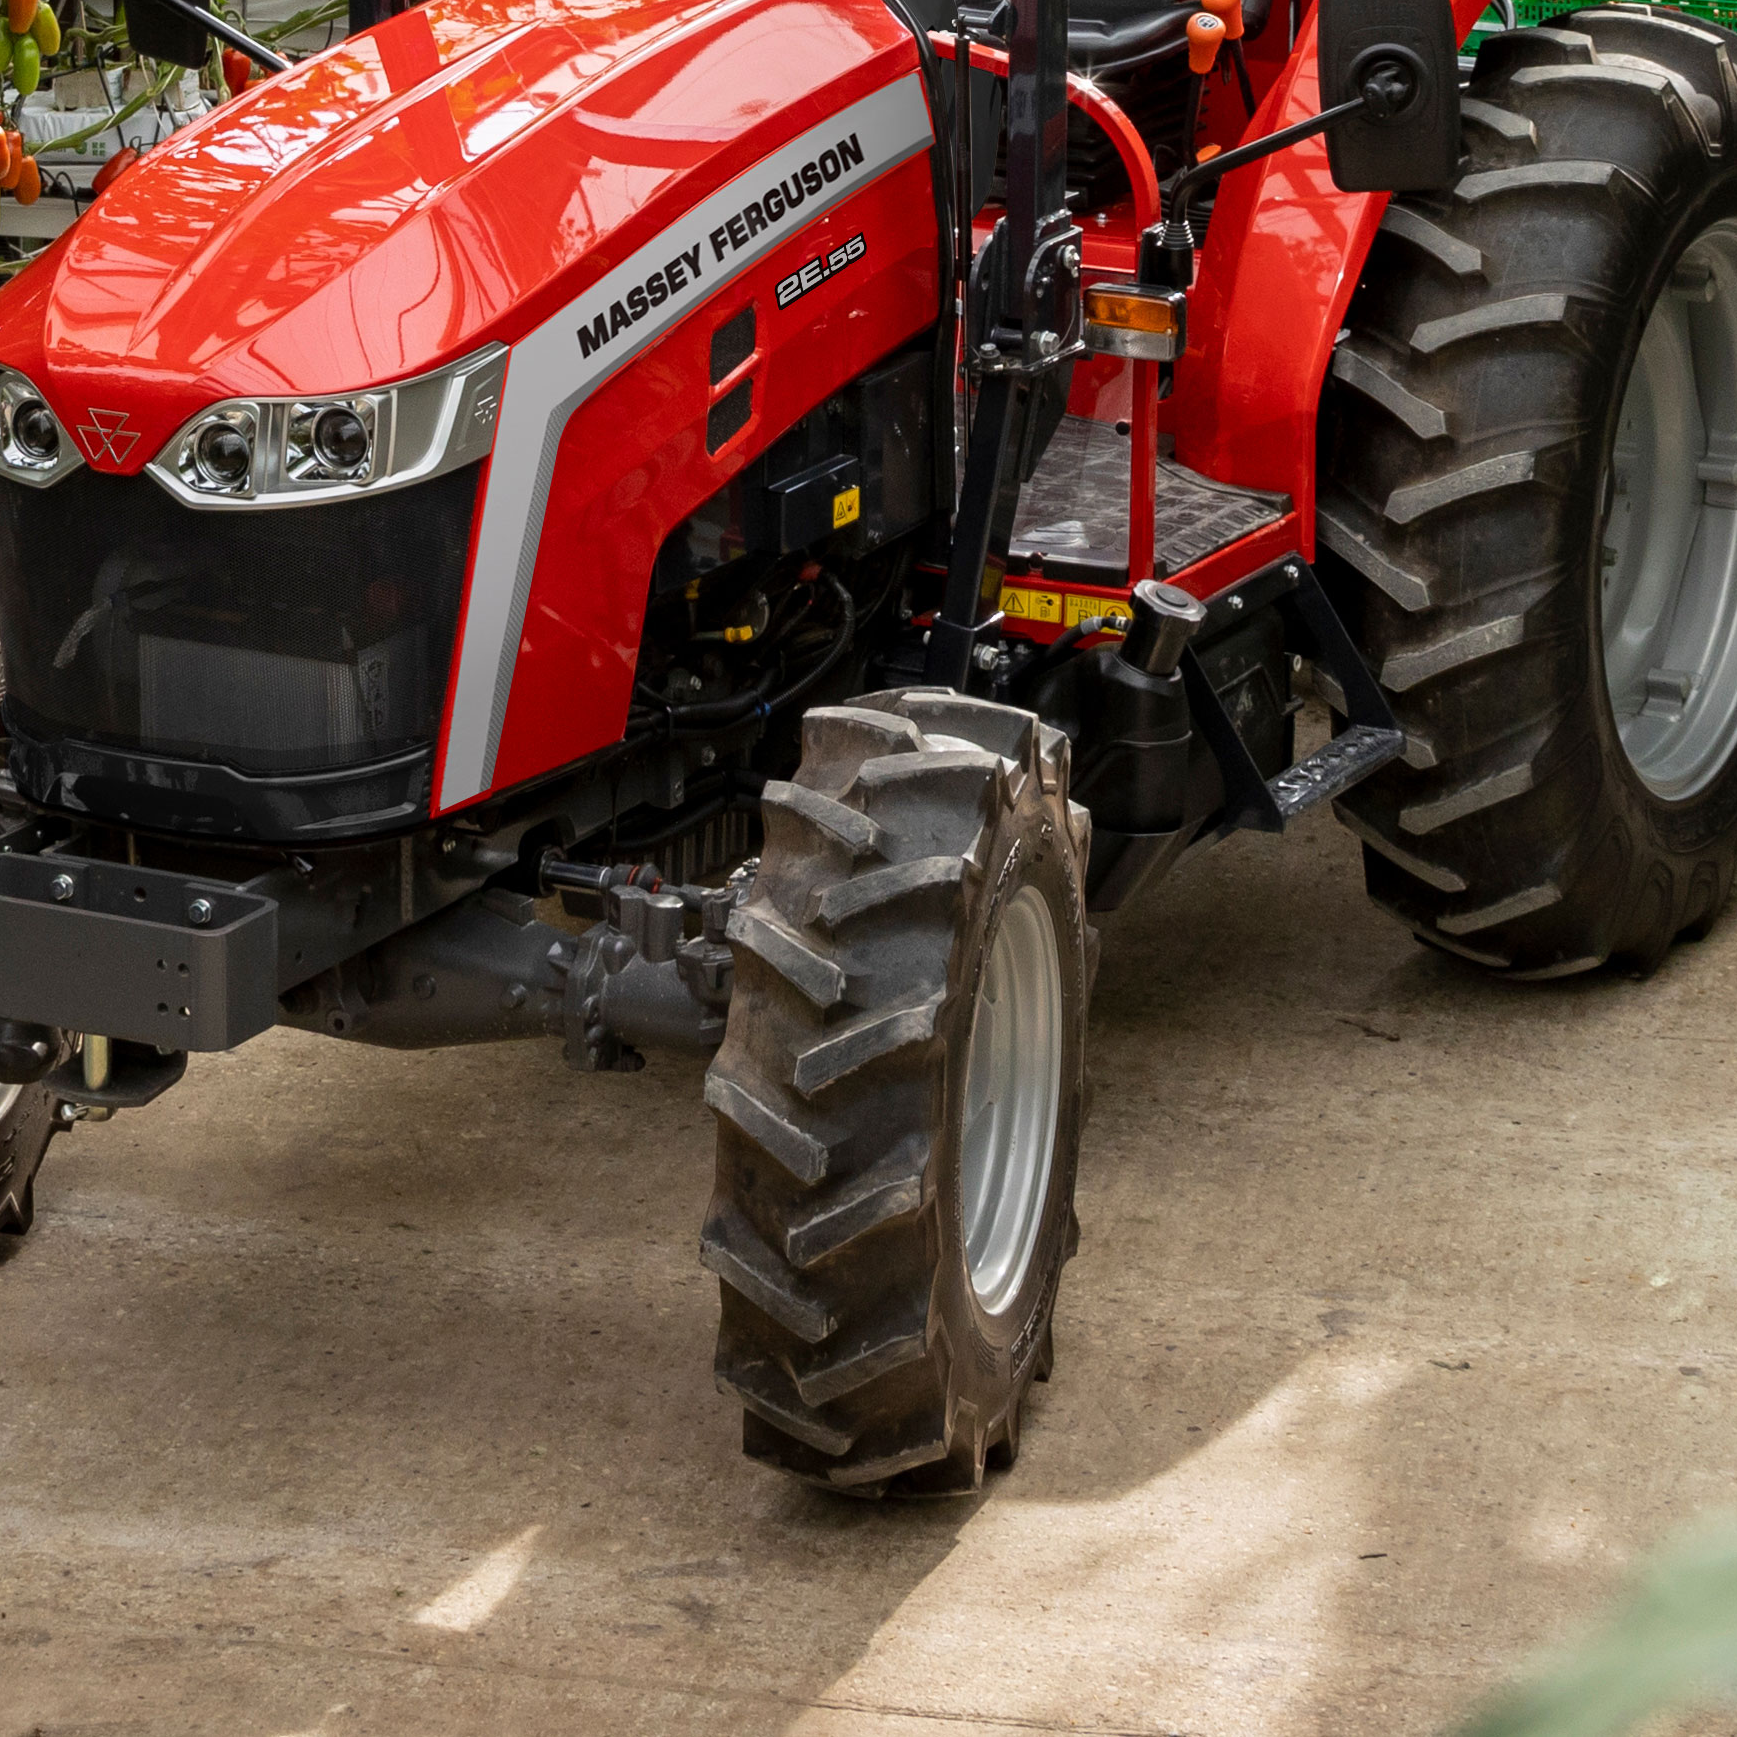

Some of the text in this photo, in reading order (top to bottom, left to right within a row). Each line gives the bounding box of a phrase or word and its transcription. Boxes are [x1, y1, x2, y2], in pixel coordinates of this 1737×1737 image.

[576, 132, 866, 359] MASSEY FERGUSON
[776, 234, 866, 309] 2E.55
